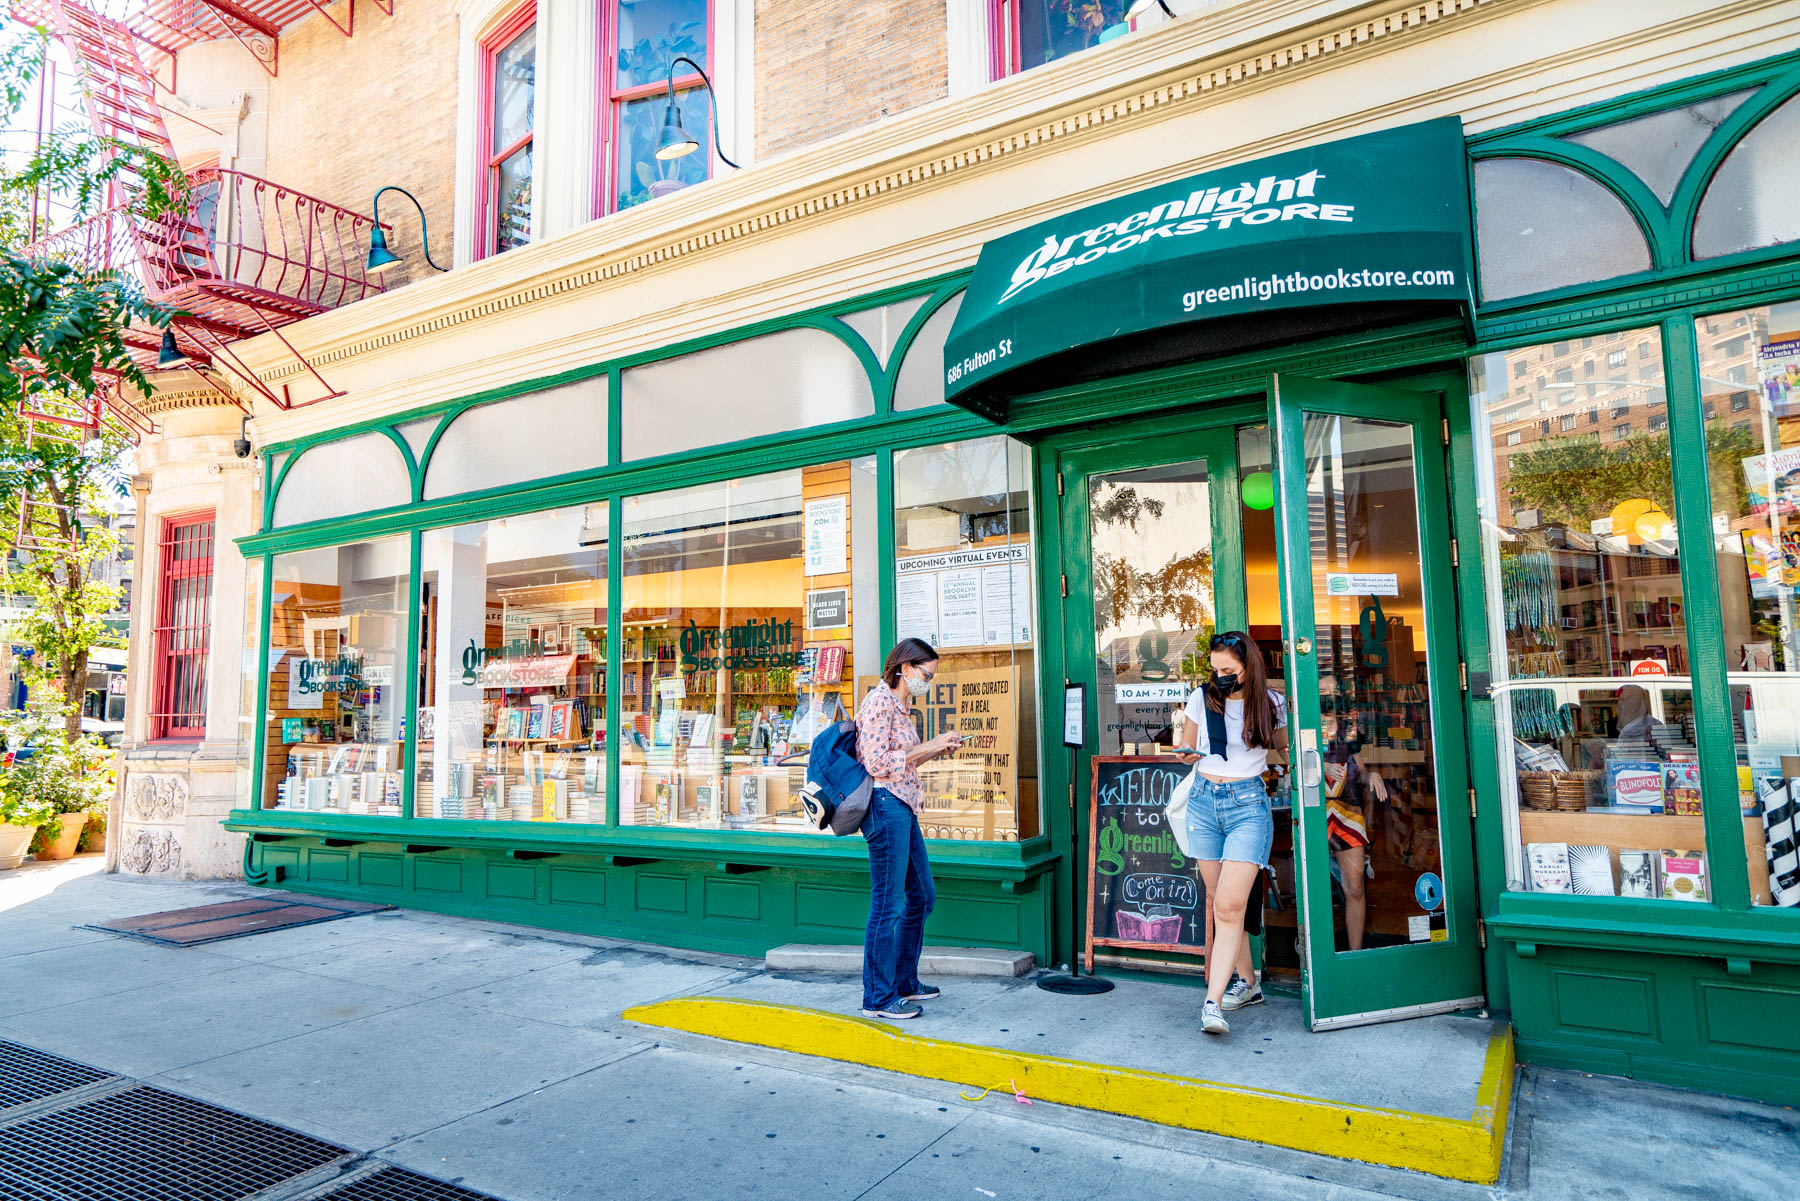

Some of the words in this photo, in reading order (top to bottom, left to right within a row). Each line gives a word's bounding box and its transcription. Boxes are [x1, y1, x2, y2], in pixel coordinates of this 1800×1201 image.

[1042, 203, 1355, 280] BOOKSTORE
[1182, 267, 1455, 312] greenlightbookstore.com
[947, 362, 962, 385] 686
[964, 348, 996, 376] Fulton
[998, 338, 1013, 358] St
[900, 557, 946, 571] UPCOMING
[948, 552, 984, 564] VIRTUAL
[986, 549, 1022, 560] EVENTS
[818, 609, 836, 617] MATTER
[680, 616, 794, 674] greenlight
[462, 638, 548, 686] greenlight
[700, 651, 806, 672] BOOKSTORE
[299, 653, 365, 694] greenlight
[477, 666, 556, 684] BOOKSTORE
[926, 683, 957, 705] LET
[962, 682, 981, 696] BOOKS
[982, 680, 1008, 696] CURATED
[1122, 689, 1133, 698] 10
[1136, 688, 1150, 698] AM
[1167, 688, 1180, 696] PM
[961, 700, 968, 714] BY
[970, 700, 974, 713] A
[975, 700, 990, 713] REAL
[1135, 706, 1160, 715] every
[960, 718, 985, 732] PERSON,
[986, 717, 998, 730] NOT
[974, 735, 998, 749] CREEPY
[994, 754, 1010, 768] THAT
[993, 772, 1001, 786] TO
[1099, 767, 1184, 806] WELCO
[1135, 808, 1160, 826] to
[1097, 817, 1185, 876] greenlig
[1126, 875, 1164, 898] Come
[1168, 880, 1193, 904] in!
